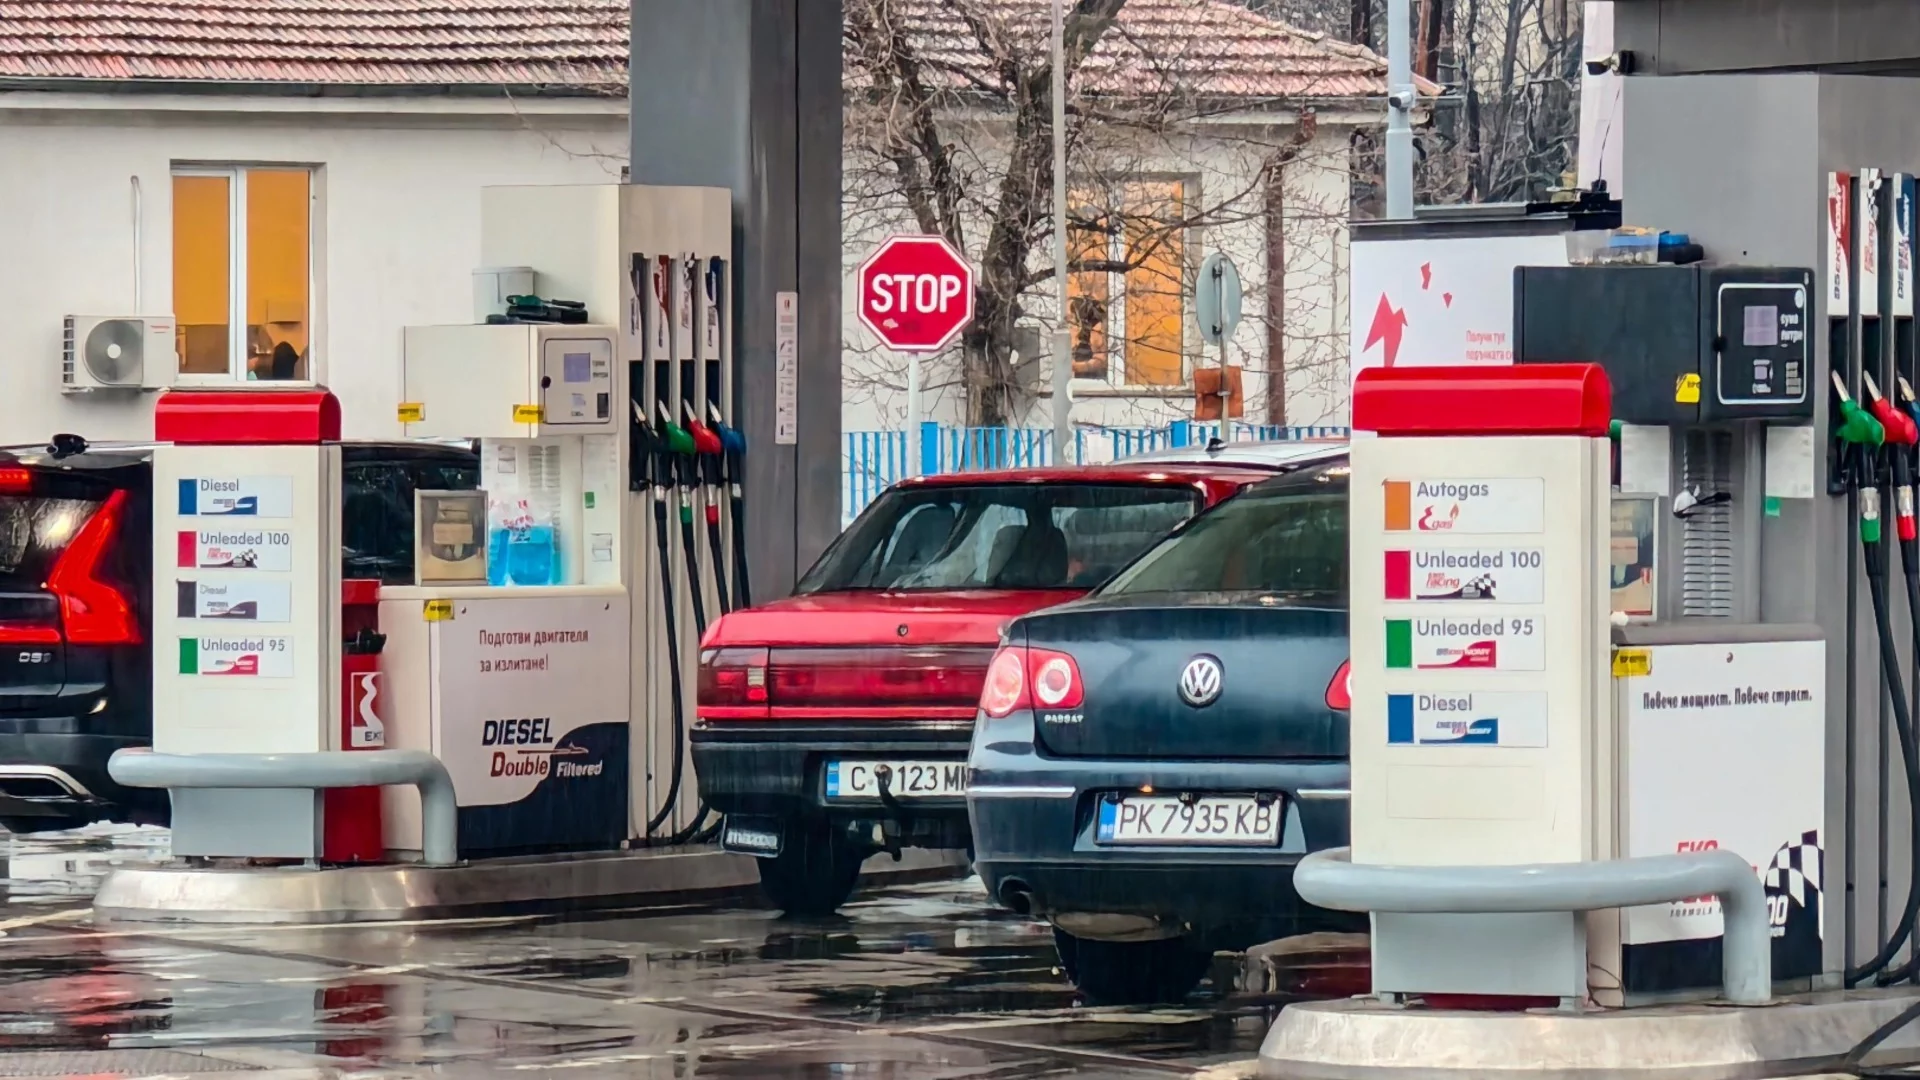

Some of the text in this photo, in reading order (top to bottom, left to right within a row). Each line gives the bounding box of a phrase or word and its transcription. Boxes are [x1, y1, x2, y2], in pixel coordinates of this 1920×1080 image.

[870, 273, 962, 313] STOP
[200, 479, 239, 492] Diesel
[1416, 482, 1490, 501] Autogas
[200, 531, 290, 546] Unleaded 100
[1415, 549, 1541, 569] Unleaded 100
[200, 585, 228, 595] Diesel
[1416, 618, 1534, 637] Unleaded 95
[201, 638, 285, 652] Unleaded 95
[479, 629, 589, 648] Подготви двигателя
[479, 653, 549, 673] за излитане!
[1419, 693, 1473, 712] Diesel
[1643, 686, 1813, 710] Повече мощност. Повече страст.
[1044, 713, 1084, 724] PASSAT
[481, 717, 554, 746] DIESEL
[490, 751, 603, 778] Double Filtered
[851, 766, 867, 791] C
[1119, 802, 1272, 834] PK 7935 KB
